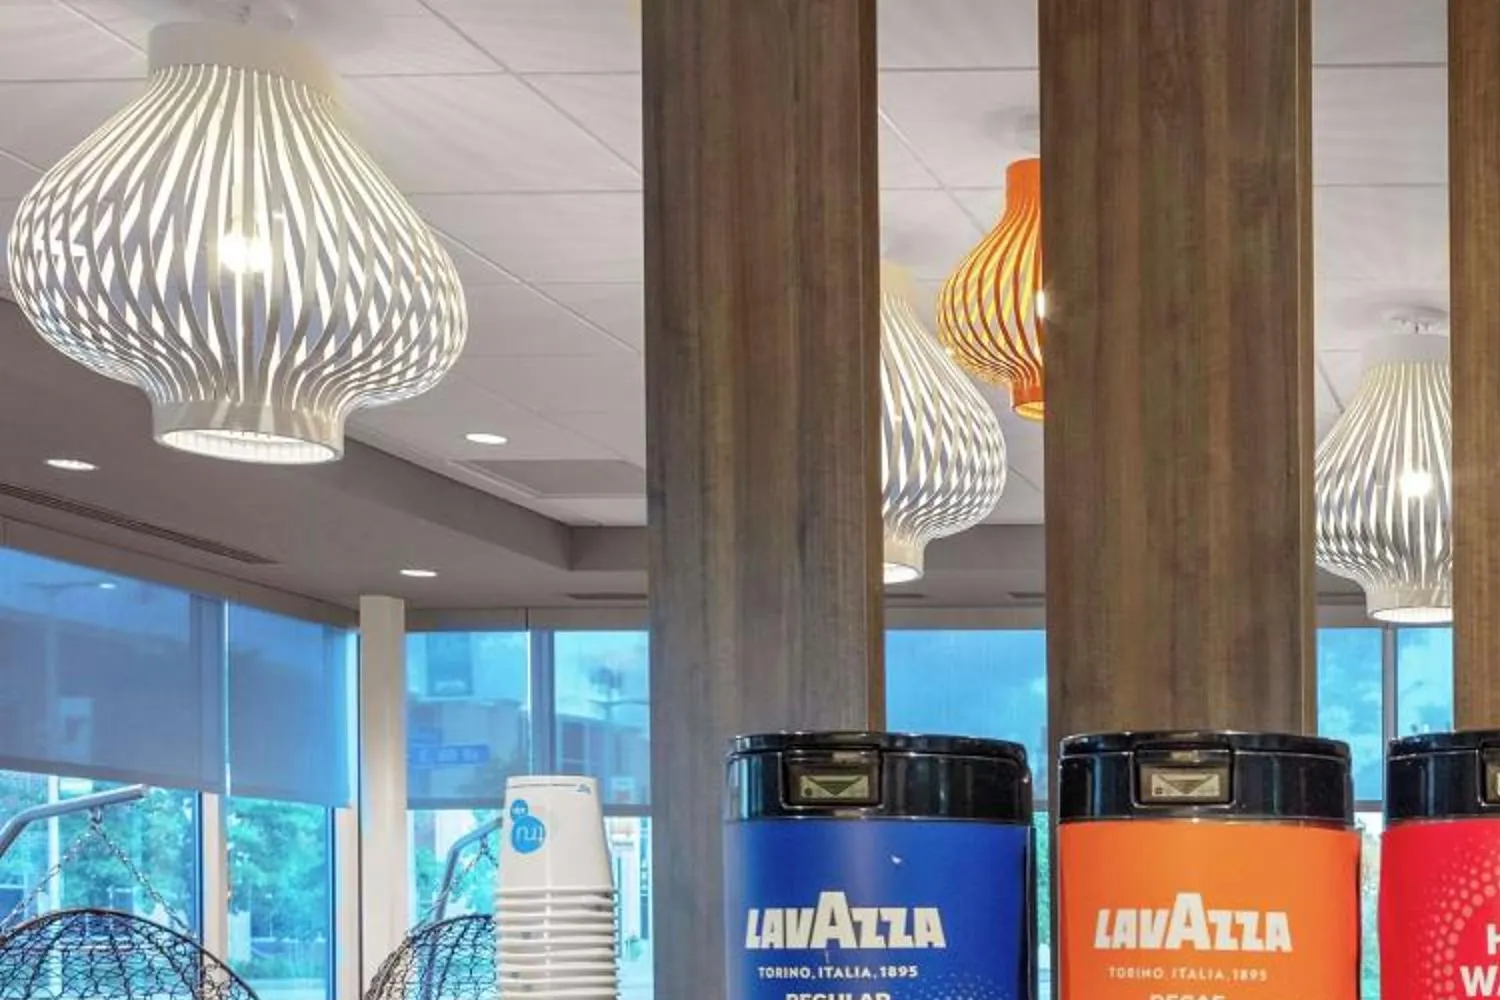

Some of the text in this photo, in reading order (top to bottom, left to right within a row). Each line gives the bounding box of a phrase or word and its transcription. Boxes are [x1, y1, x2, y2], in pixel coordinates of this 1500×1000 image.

[745, 891, 946, 949] LAVAZZA
[1094, 892, 1292, 952] LAVAZZA
[880, 965, 918, 978] 1895
[1232, 968, 1268, 982] 1895
